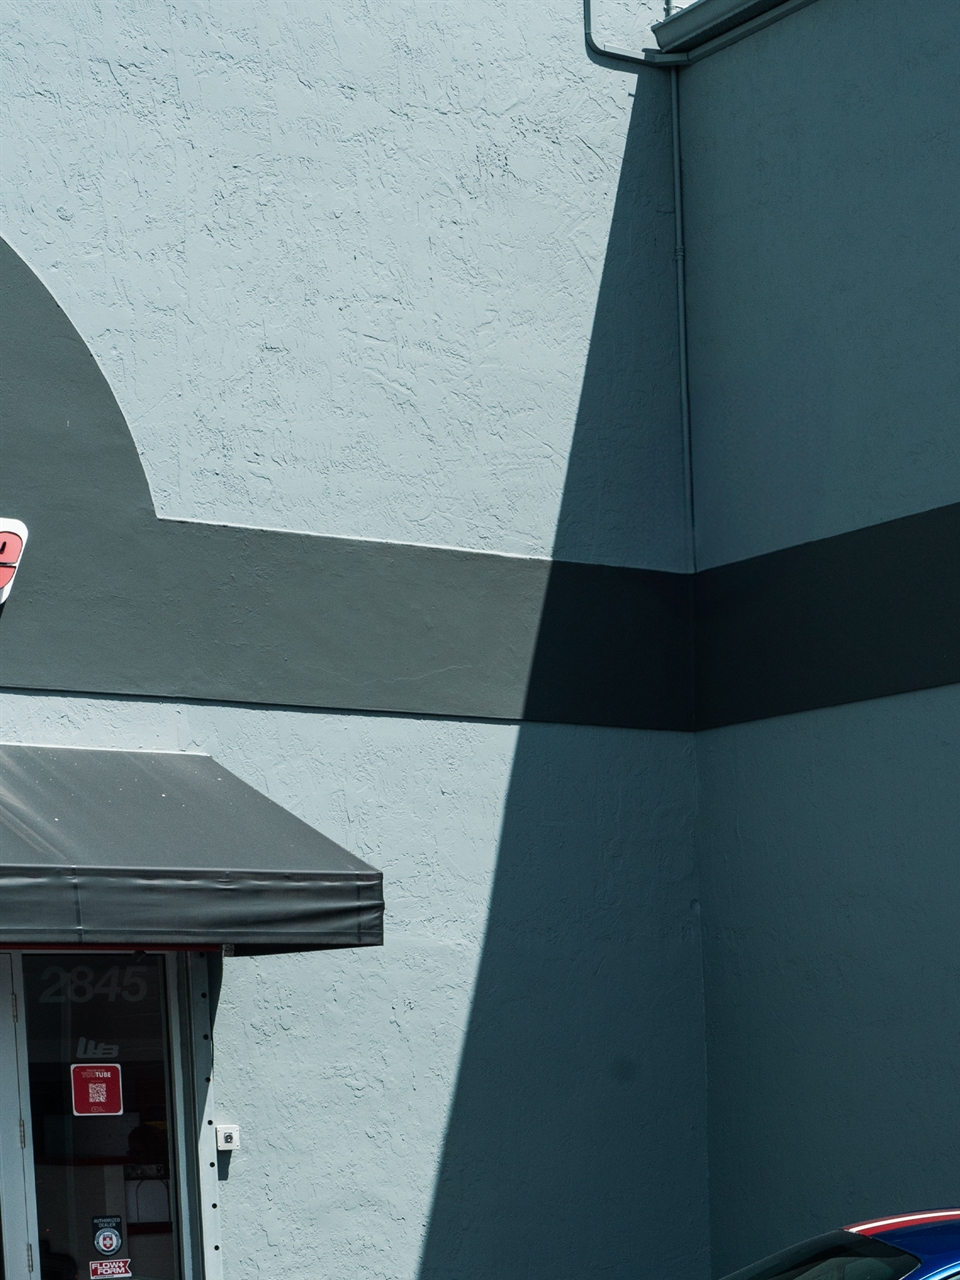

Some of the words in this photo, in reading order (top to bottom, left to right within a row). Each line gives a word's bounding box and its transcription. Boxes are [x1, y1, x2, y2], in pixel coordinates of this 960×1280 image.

[38, 965, 148, 1003] 2845
[80, 1071, 112, 1079] YOUTUBE
[97, 1267, 126, 1275] FORM
